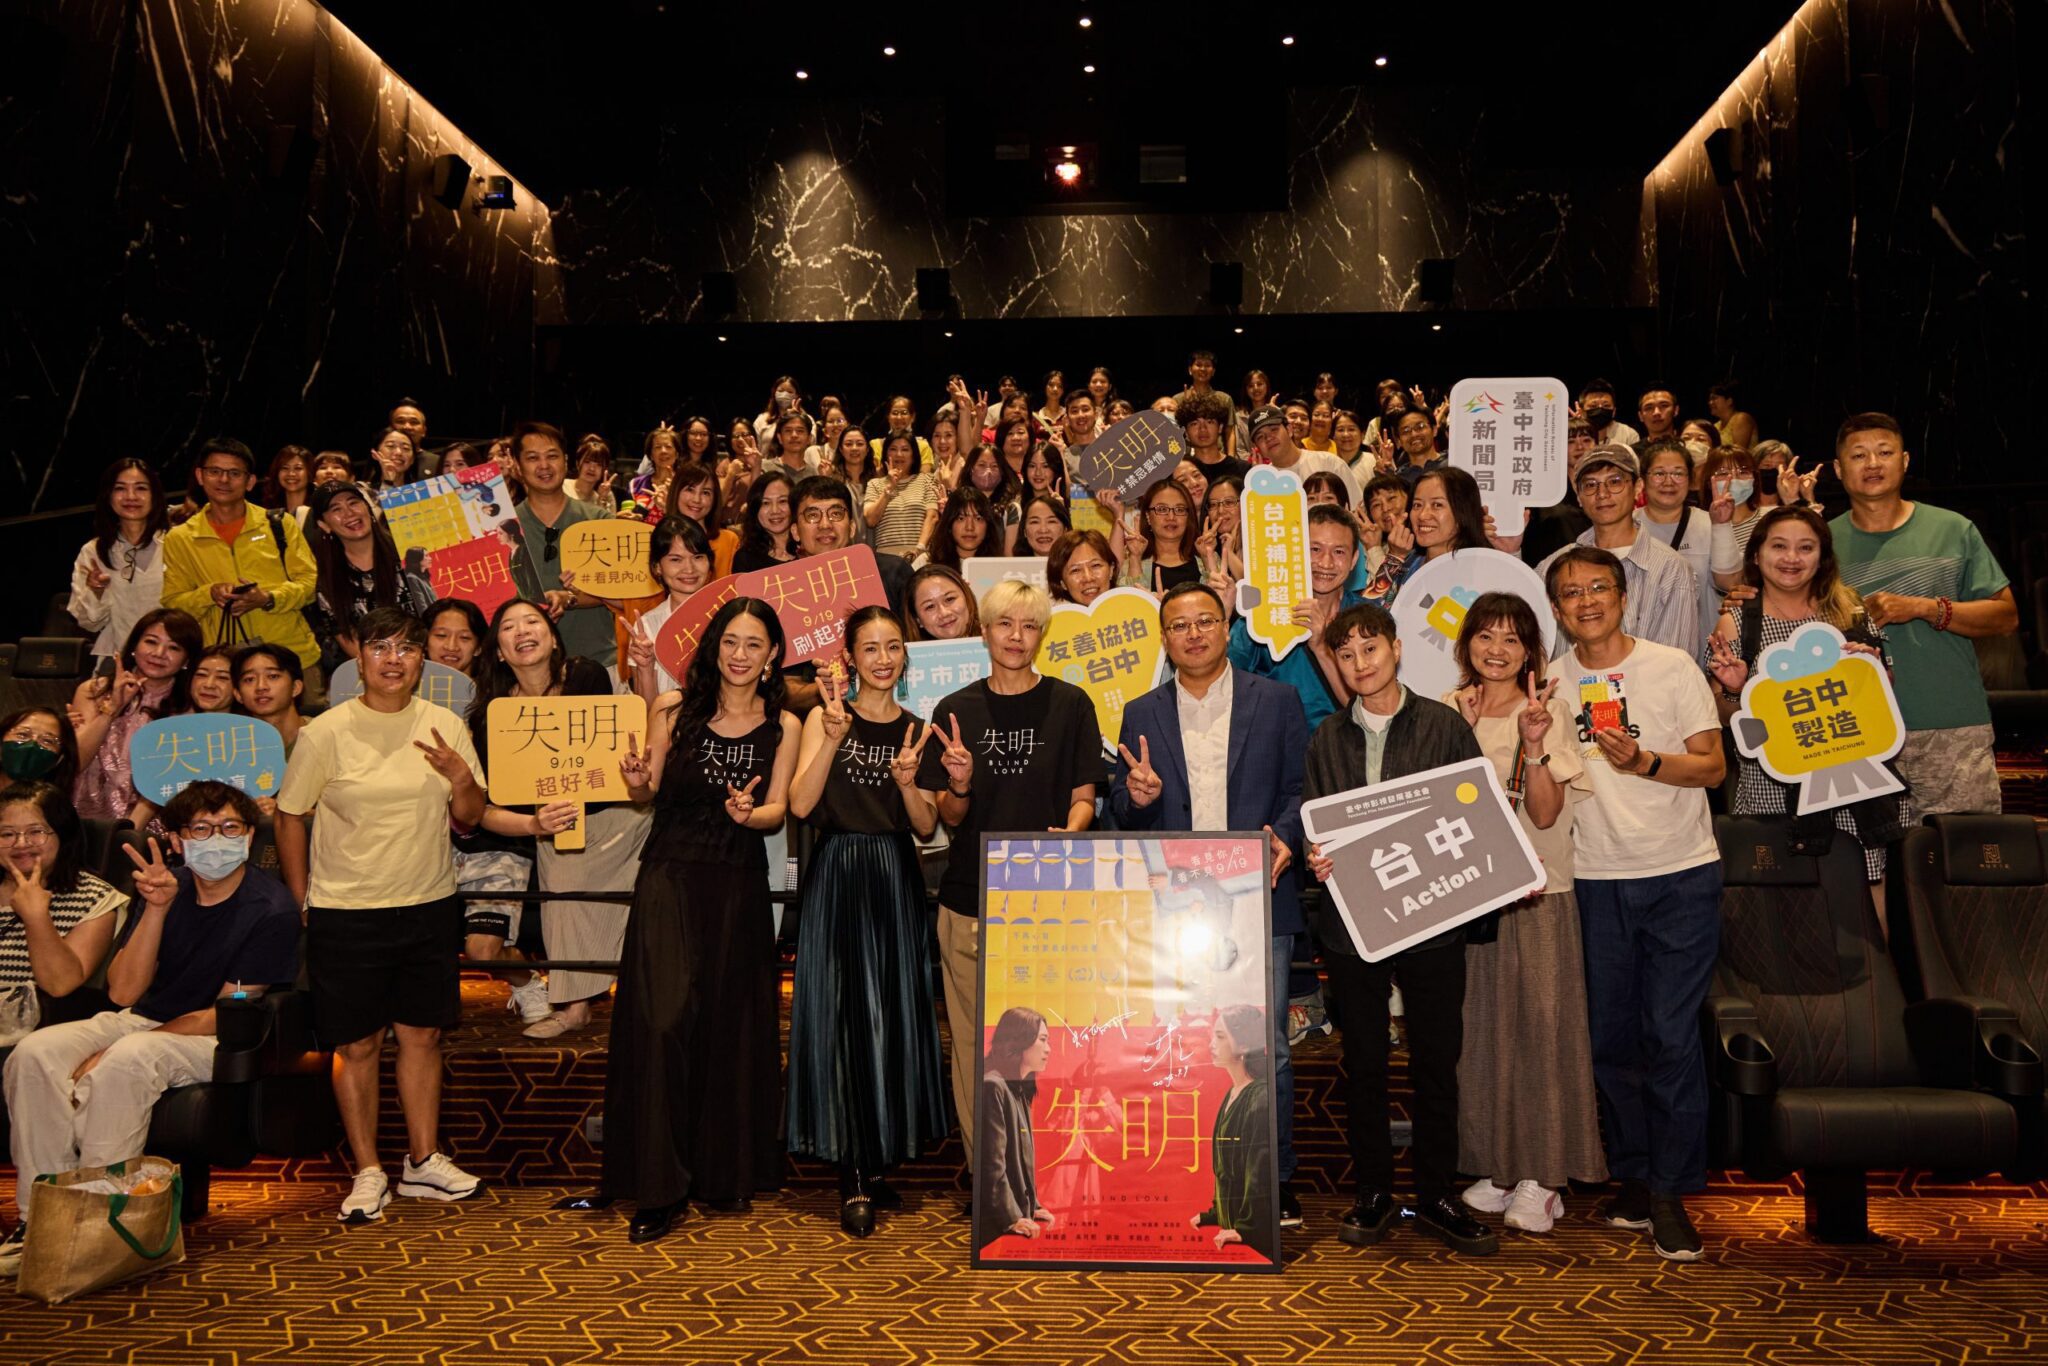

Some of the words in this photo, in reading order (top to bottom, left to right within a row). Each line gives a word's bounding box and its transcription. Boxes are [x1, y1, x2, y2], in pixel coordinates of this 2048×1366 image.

[1093, 416, 1162, 485] 失明
[1472, 419, 1497, 492] 新聞局
[1512, 391, 1534, 496] 臺中市政府
[577, 531, 652, 568] 失明
[1264, 502, 1292, 626] 台中補助超棒
[437, 552, 509, 597] 失明
[763, 556, 858, 614] 失明
[803, 609, 834, 627] 9/19
[1046, 617, 1148, 663] 友善協拍
[1783, 678, 1848, 717] 台中
[511, 704, 618, 754] 失明
[980, 728, 1036, 755] 失明
[1792, 710, 1862, 748] 製造
[155, 724, 257, 779] 失明
[550, 756, 585, 769] 9/19
[698, 738, 756, 770] 失明
[841, 738, 897, 768] 失明
[989, 759, 1029, 767] BLIND
[1803, 751, 1822, 760] MADE
[1832, 740, 1866, 753] TAICHUNG
[535, 768, 606, 799] 超好看
[704, 768, 748, 780] BLIND
[708, 777, 741, 787] LOVE
[847, 767, 889, 779] BLIND
[851, 776, 882, 787] LOVE
[994, 767, 1024, 775] LOVE
[1216, 851, 1247, 874] 9/19
[1370, 816, 1475, 891] 台中
[1401, 864, 1482, 917] Action
[1038, 1086, 1202, 1175] 失明
